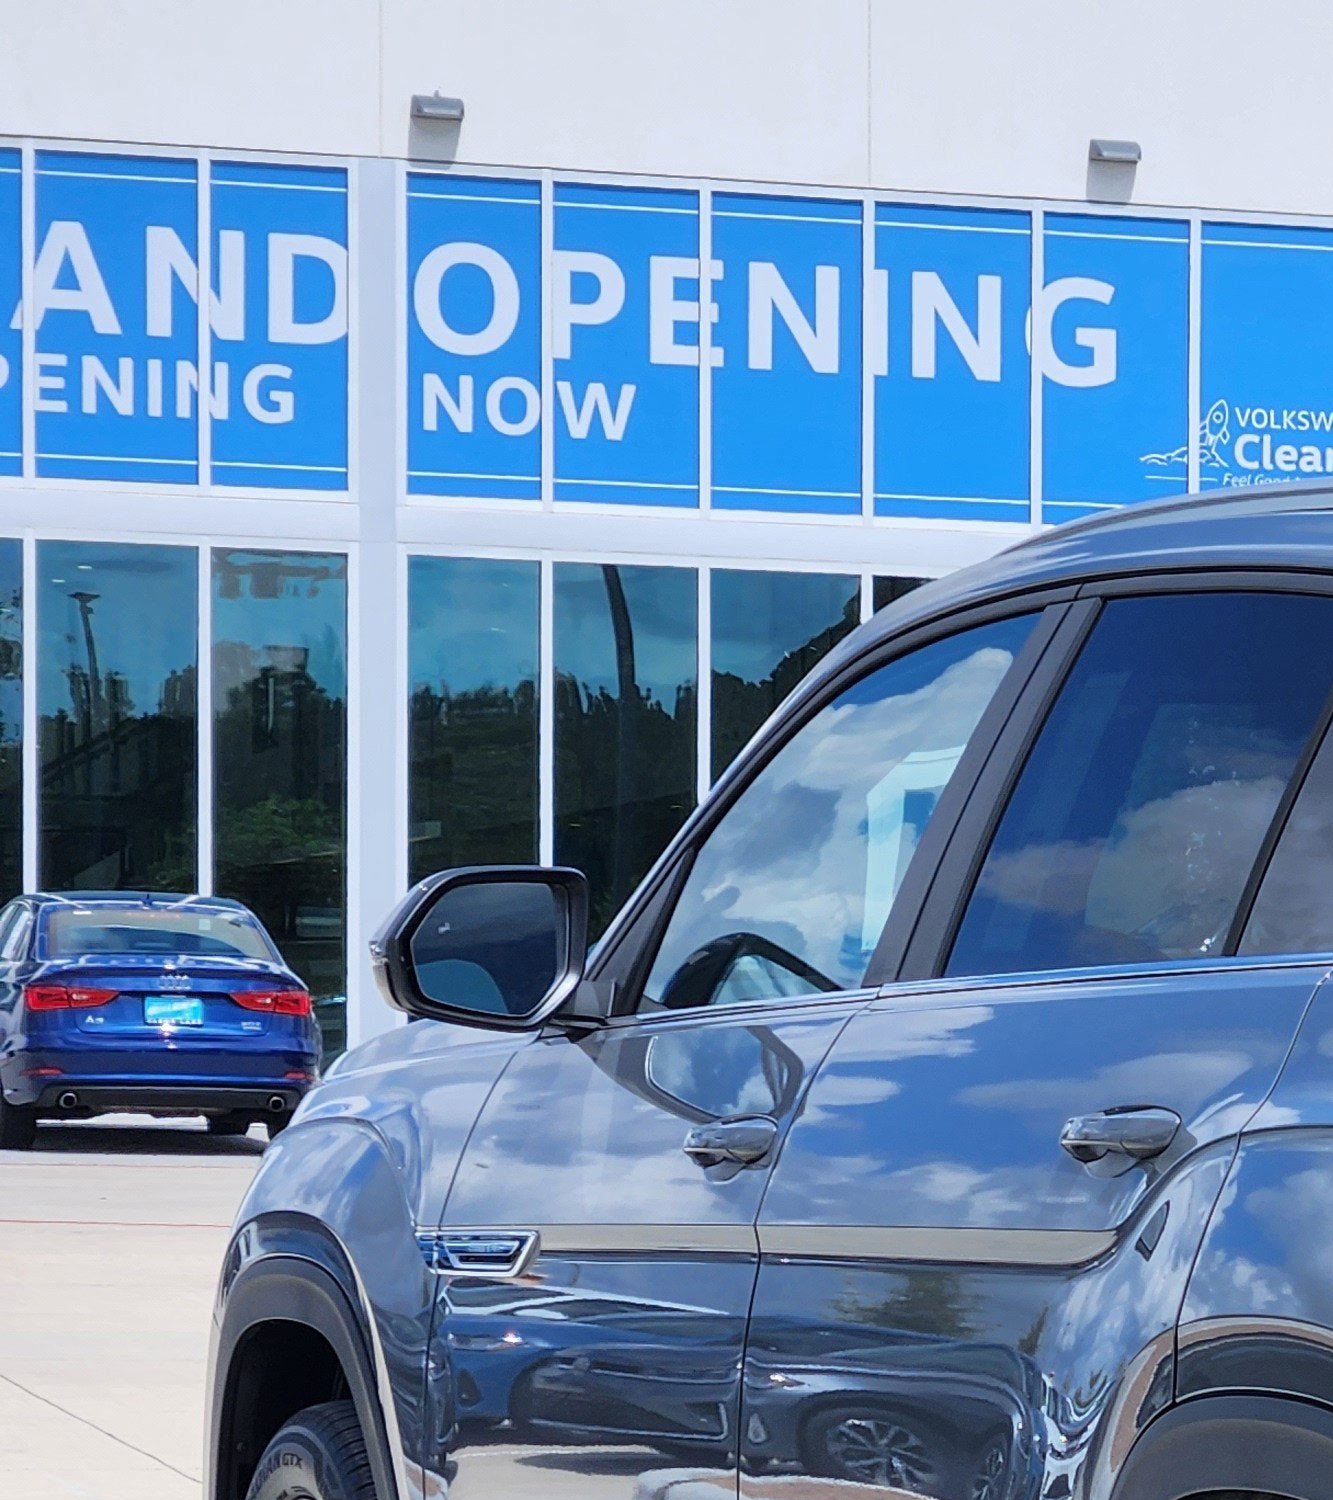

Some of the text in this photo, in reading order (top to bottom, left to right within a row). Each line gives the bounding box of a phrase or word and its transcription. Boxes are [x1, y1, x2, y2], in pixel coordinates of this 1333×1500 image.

[10, 220, 1118, 388] AND OPENING
[422, 372, 637, 441] NOW
[1223, 472, 1252, 487] Feel
